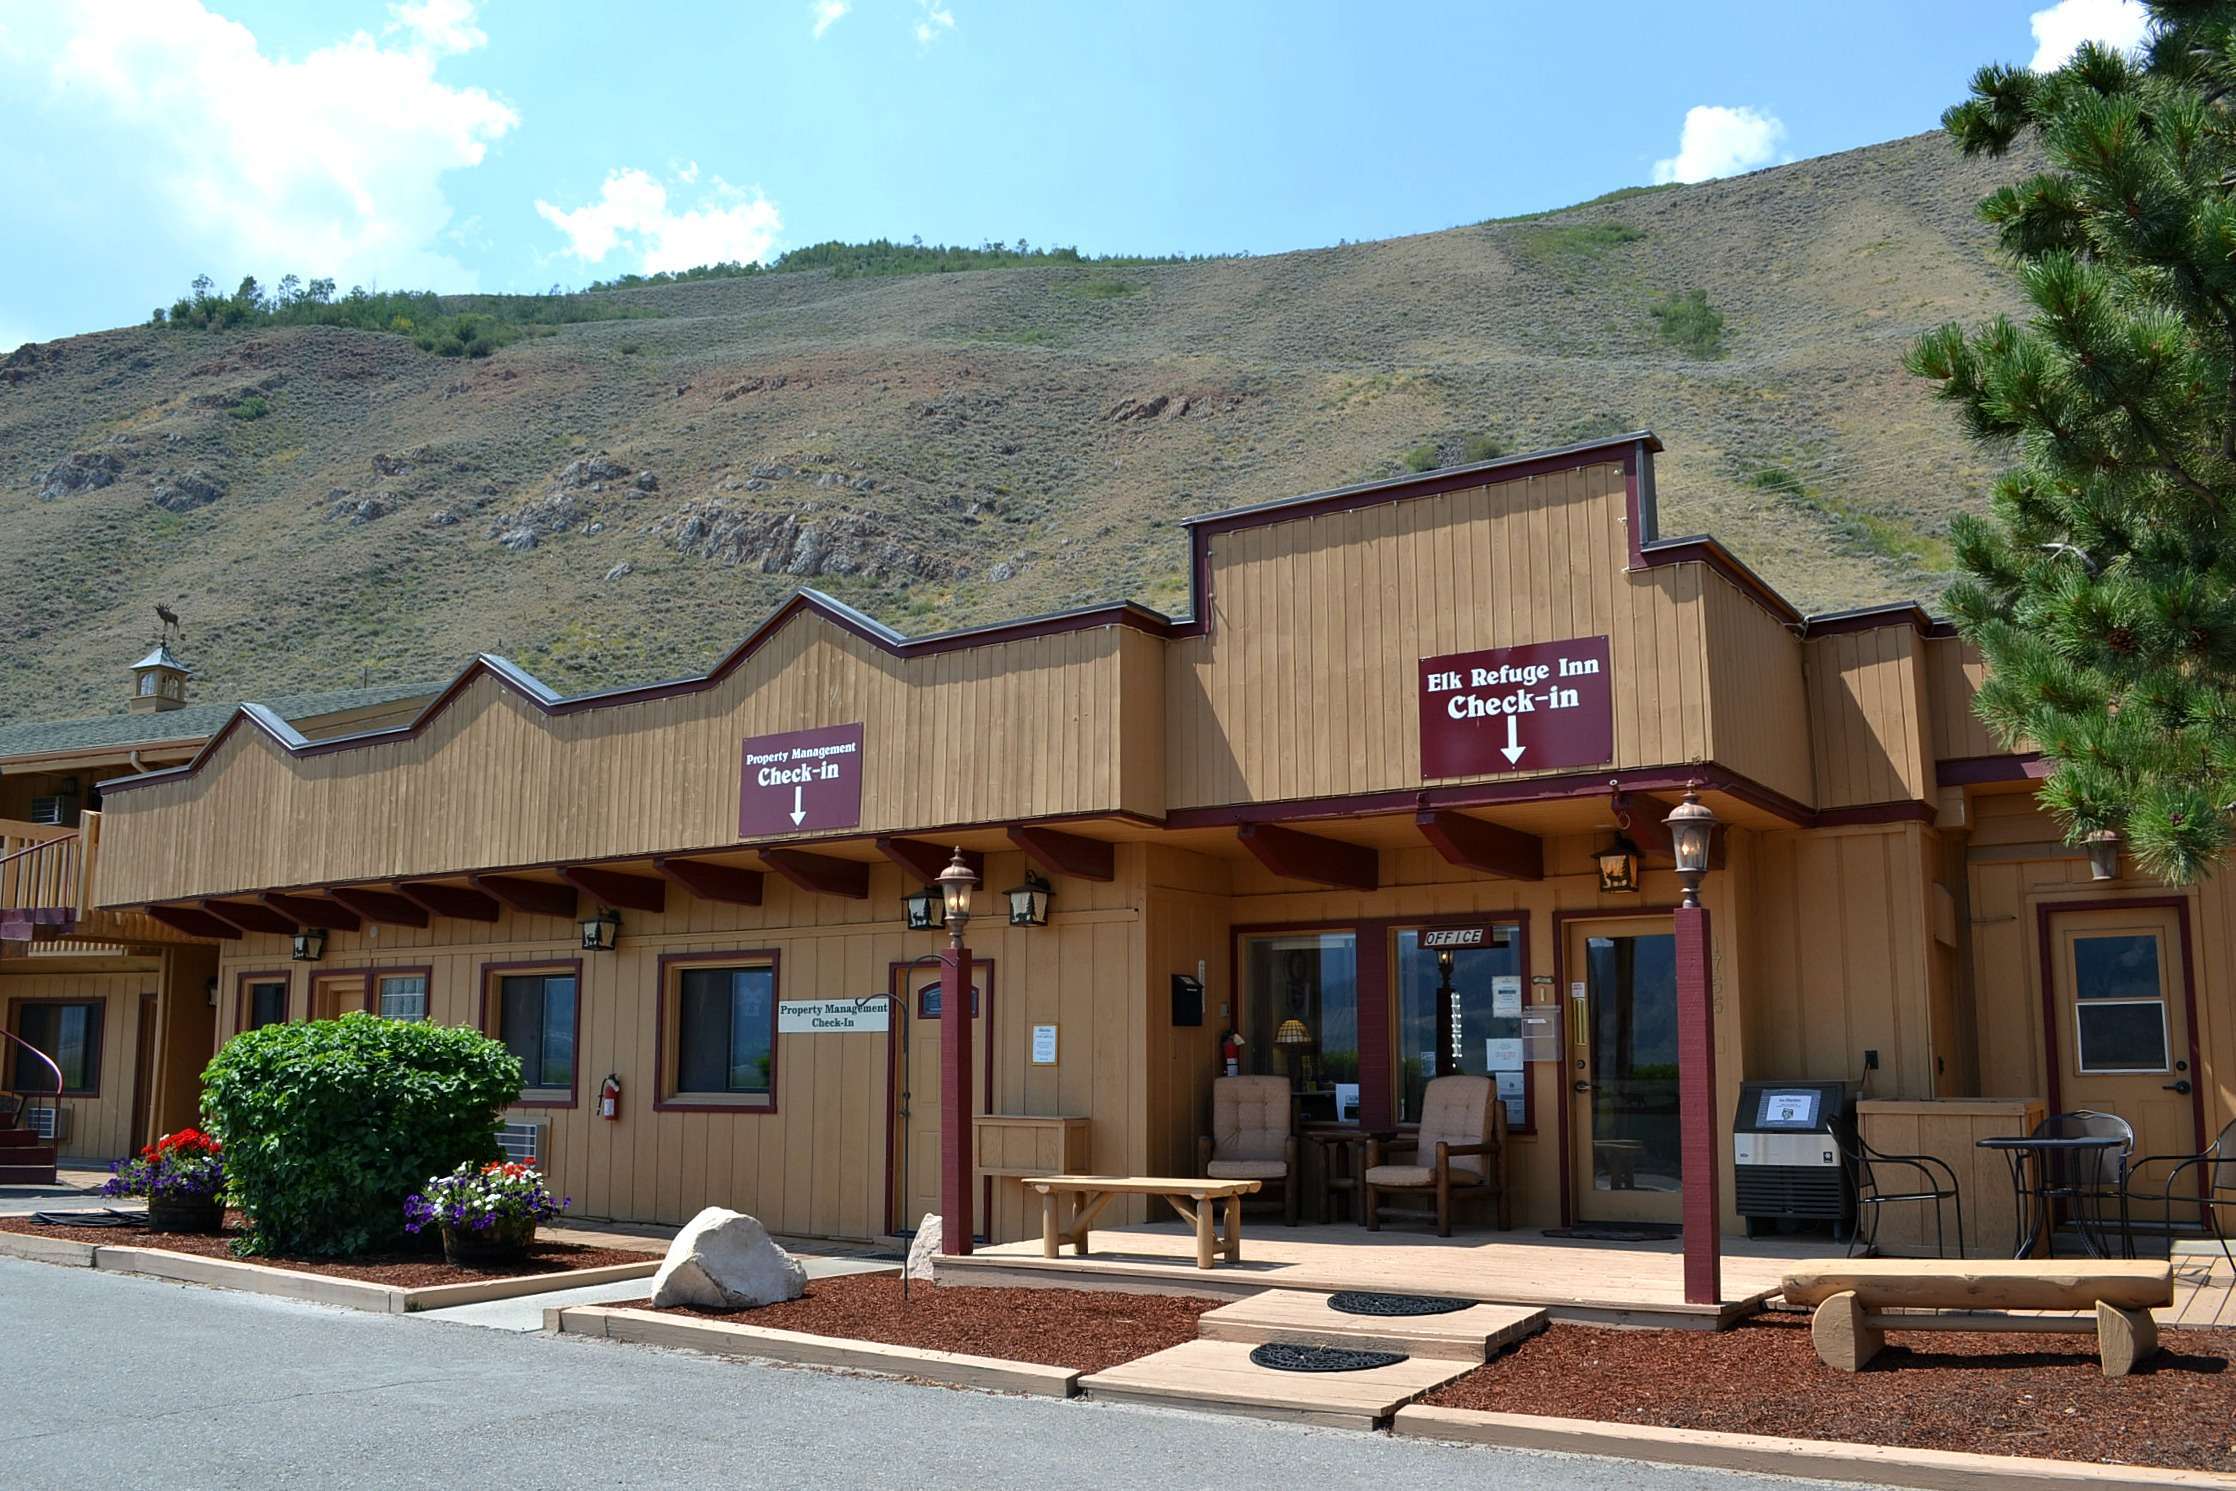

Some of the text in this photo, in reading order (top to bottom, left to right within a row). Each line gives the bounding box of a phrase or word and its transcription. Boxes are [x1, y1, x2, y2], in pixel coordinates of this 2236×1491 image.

[1427, 658, 1600, 692] Elk Refuge Inn
[1448, 685, 1580, 719] Check-in
[746, 742, 856, 765] Property Management
[758, 761, 839, 787] Check-in
[1426, 931, 1481, 944] OFFICE
[780, 1003, 888, 1017] Property Management
[811, 1018, 855, 1028] Check-In
